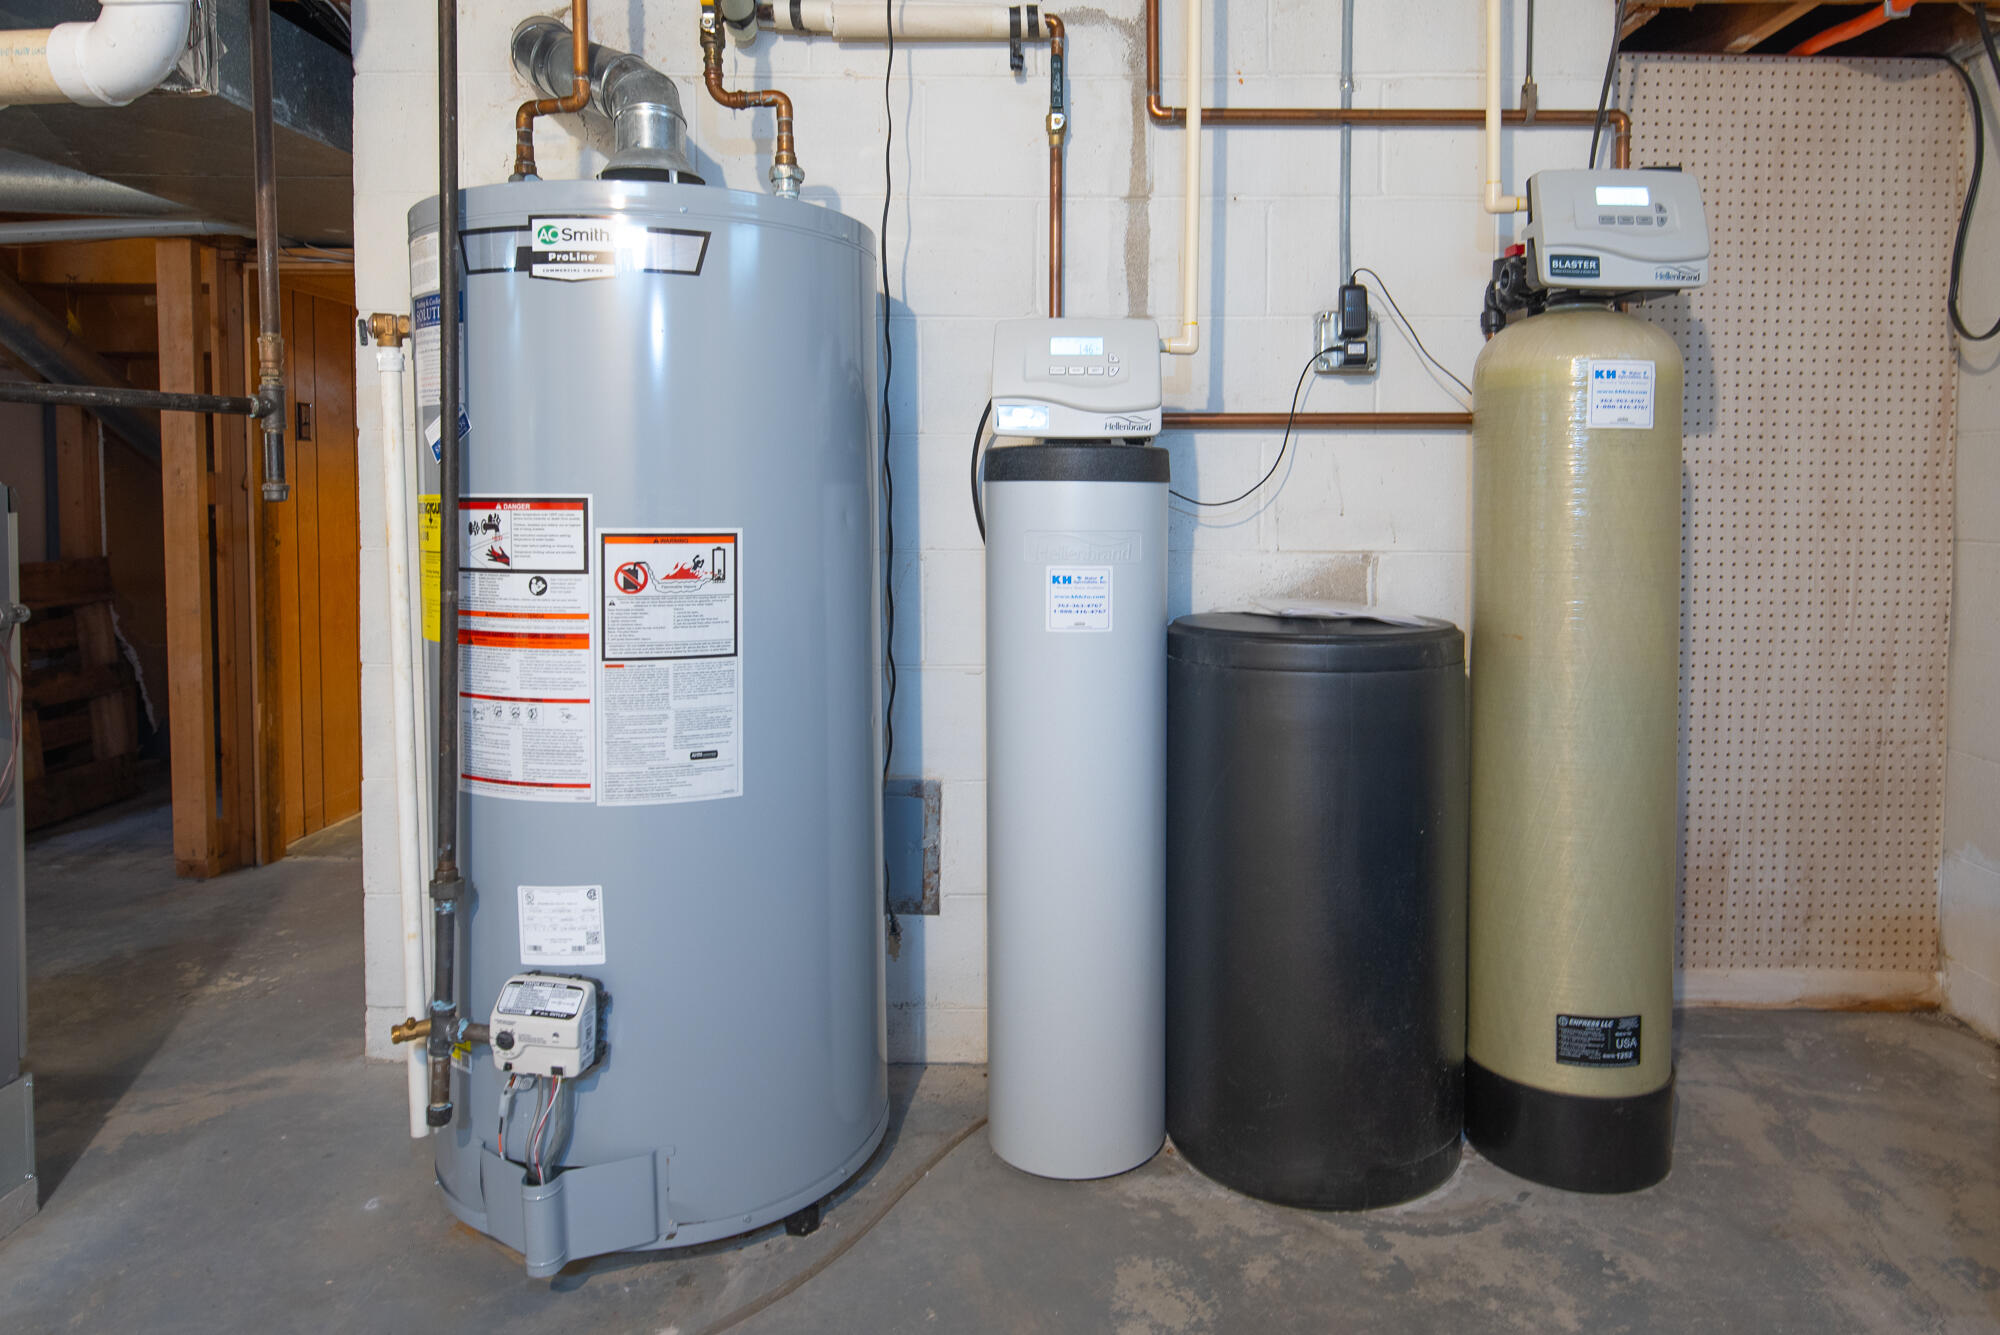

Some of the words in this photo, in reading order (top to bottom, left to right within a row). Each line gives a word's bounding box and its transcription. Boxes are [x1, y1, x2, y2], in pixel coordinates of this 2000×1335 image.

[562, 227, 610, 242] Smith
[548, 252, 595, 262] ProLine
[1552, 259, 1597, 270] BLASTER
[1655, 270, 1701, 282] Hellenbrand
[1595, 370, 1616, 379] KH
[1104, 421, 1152, 431] Hellenbrand
[1052, 575, 1072, 584] KH
[1616, 1037, 1638, 1049] USA
